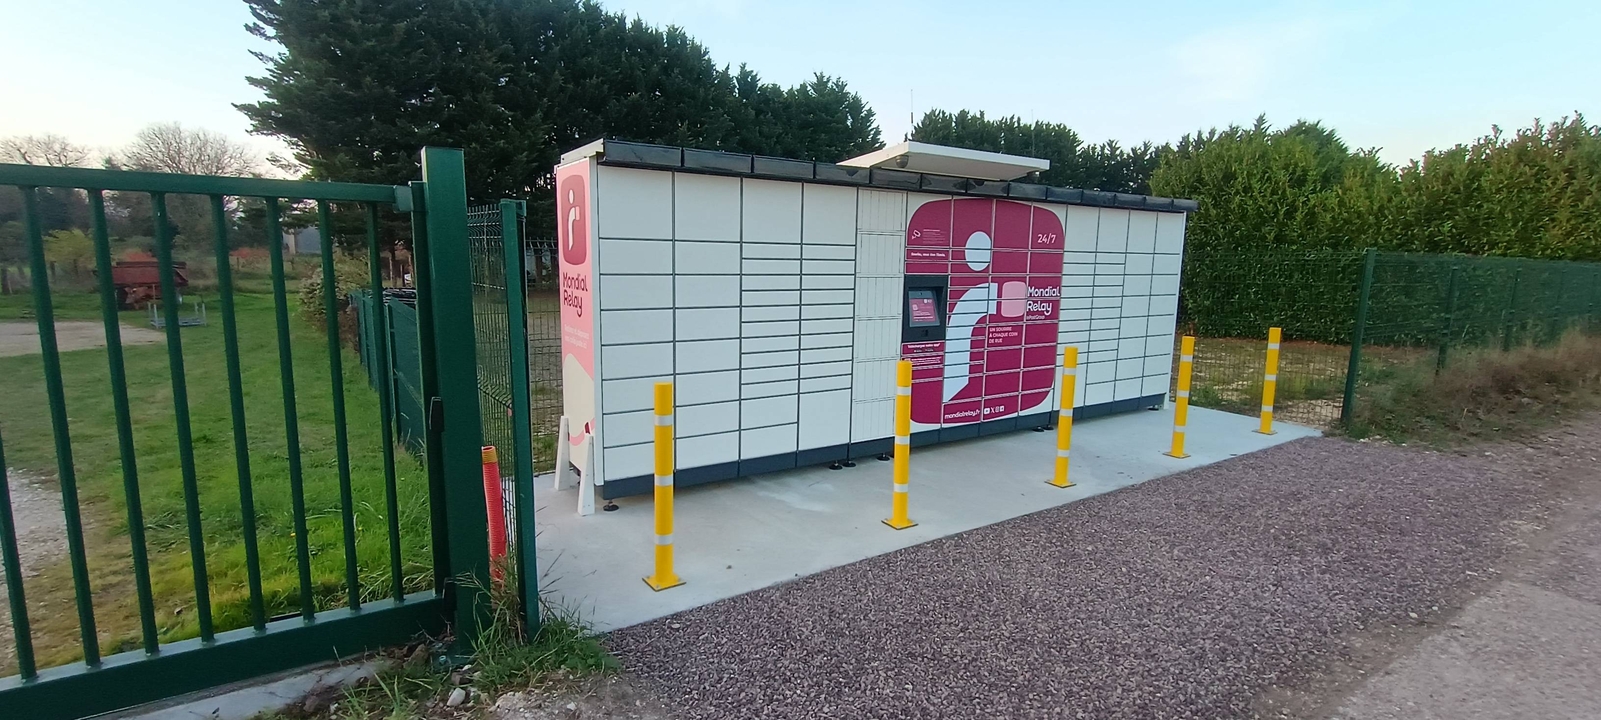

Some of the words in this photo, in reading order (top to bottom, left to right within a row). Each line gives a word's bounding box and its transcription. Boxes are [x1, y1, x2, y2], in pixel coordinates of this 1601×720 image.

[1037, 233, 1056, 245] 24/7
[563, 272, 588, 292] Mondial
[1028, 286, 1060, 297] Mondial
[564, 289, 583, 318] Relay
[1026, 301, 1052, 315] Relay
[944, 409, 980, 419] mondialrelay.fr
